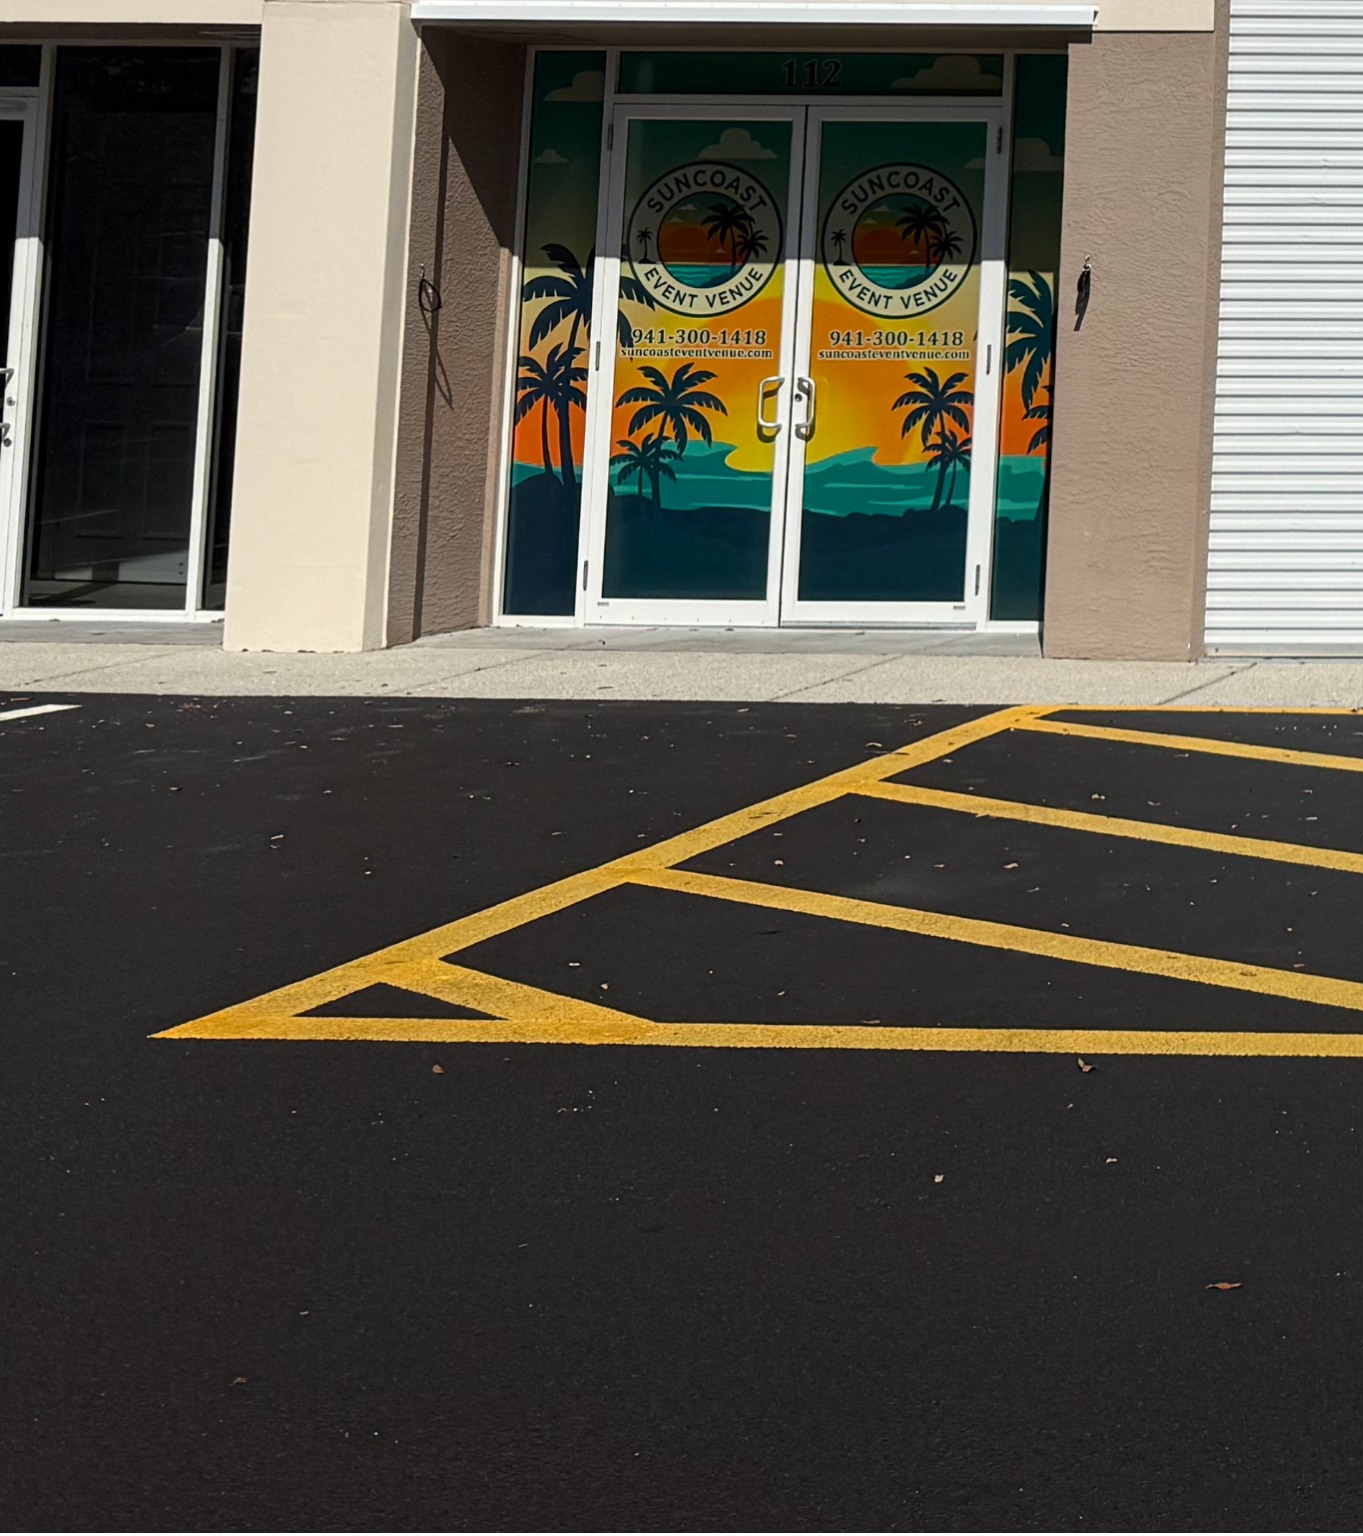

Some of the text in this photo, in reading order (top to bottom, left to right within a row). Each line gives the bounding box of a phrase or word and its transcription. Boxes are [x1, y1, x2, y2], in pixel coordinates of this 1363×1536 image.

[781, 59, 842, 88] 112
[647, 170, 768, 213] SUNCOAST
[841, 171, 961, 215] SUNCOAST
[644, 267, 763, 308] EVENT VENUE
[838, 269, 958, 309] EVENT VENUE
[632, 329, 766, 345] 941-300-1418
[830, 331, 963, 346] 941-300-1418
[621, 348, 773, 359] suncoasteventvenue.com
[818, 350, 970, 360] suncoasteventvenue.com
